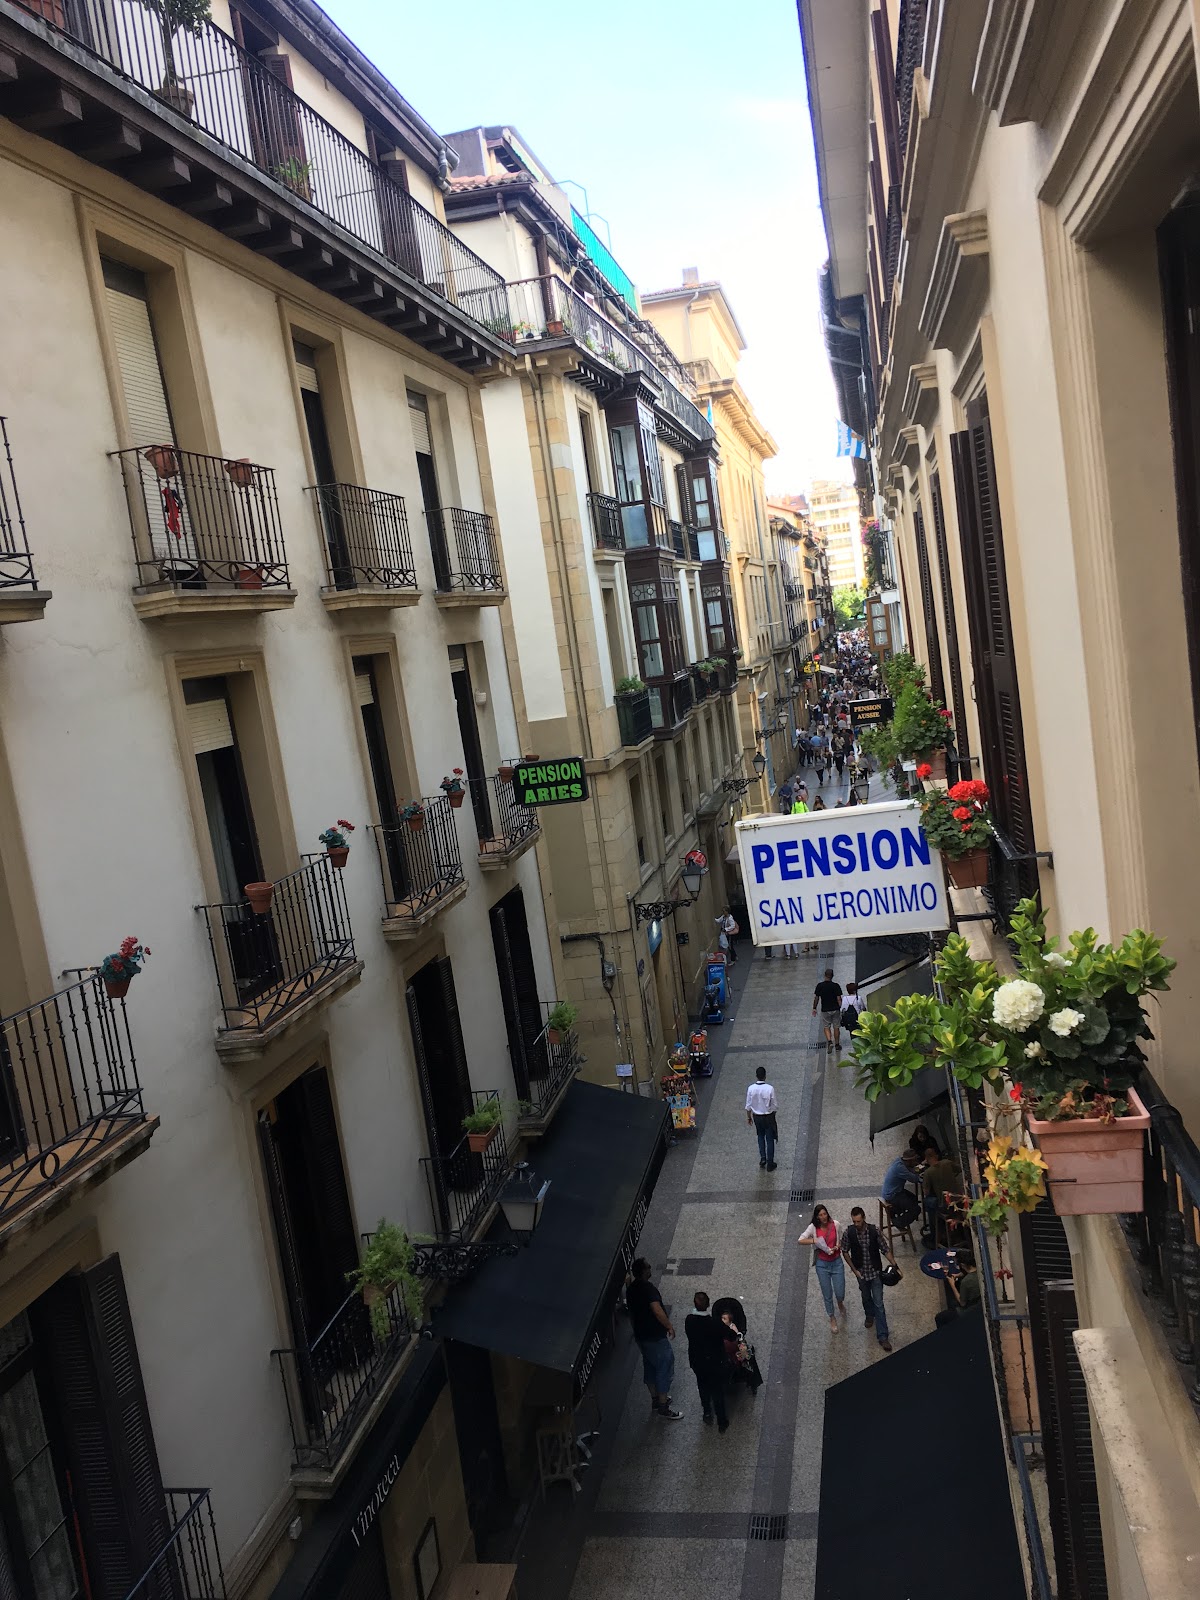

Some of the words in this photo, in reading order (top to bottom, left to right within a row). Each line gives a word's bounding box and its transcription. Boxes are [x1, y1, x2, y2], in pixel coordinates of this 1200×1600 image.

[853, 704, 882, 713] PENSION
[857, 711, 881, 720] AUSSIE
[519, 762, 581, 785] PENSION
[525, 784, 583, 803] ARIES
[751, 825, 932, 884] PENSION
[759, 892, 805, 928] SAN
[813, 882, 938, 922] JERONIMO
